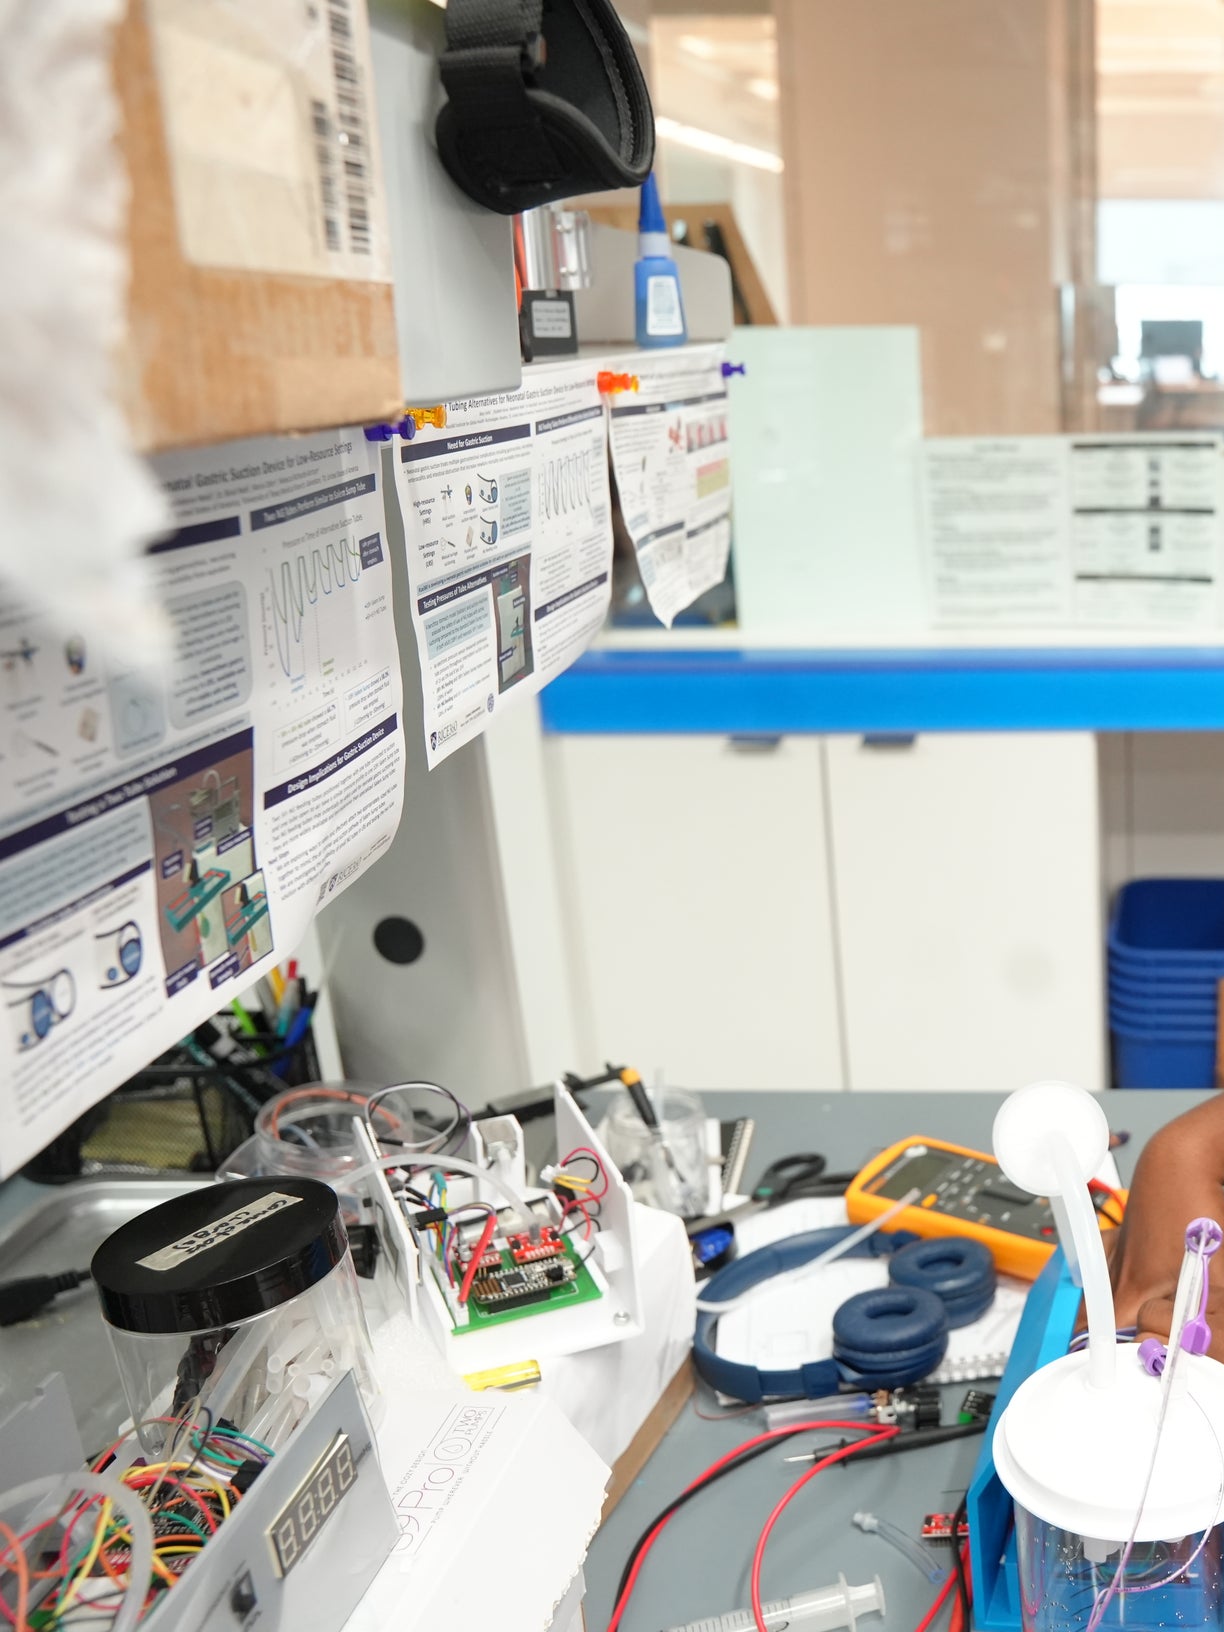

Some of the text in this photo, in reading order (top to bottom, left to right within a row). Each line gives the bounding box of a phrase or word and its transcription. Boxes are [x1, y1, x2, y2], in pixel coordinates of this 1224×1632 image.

[449, 401, 468, 412] Tubing
[468, 396, 498, 409] Alternatives
[506, 390, 525, 402] Neonatal
[526, 390, 540, 400] Gastric
[447, 440, 458, 450] Need
[465, 436, 479, 447] Gastric
[479, 434, 493, 444] Suction
[230, 464, 262, 482] Suction
[263, 459, 286, 474] Device
[346, 486, 356, 498] Sump
[356, 482, 366, 492] Tube
[423, 598, 437, 610] Testing
[436, 588, 454, 603] Pressures
[458, 584, 466, 594] Tube
[466, 576, 488, 590] Alternatives
[287, 778, 308, 794] Design
[308, 760, 337, 784] Implications
[344, 746, 358, 760] Gastric
[358, 736, 372, 752] Suction
[372, 728, 384, 741] Device
[452, 1408, 477, 1434] TWO
[464, 1410, 488, 1436] PUMPS
